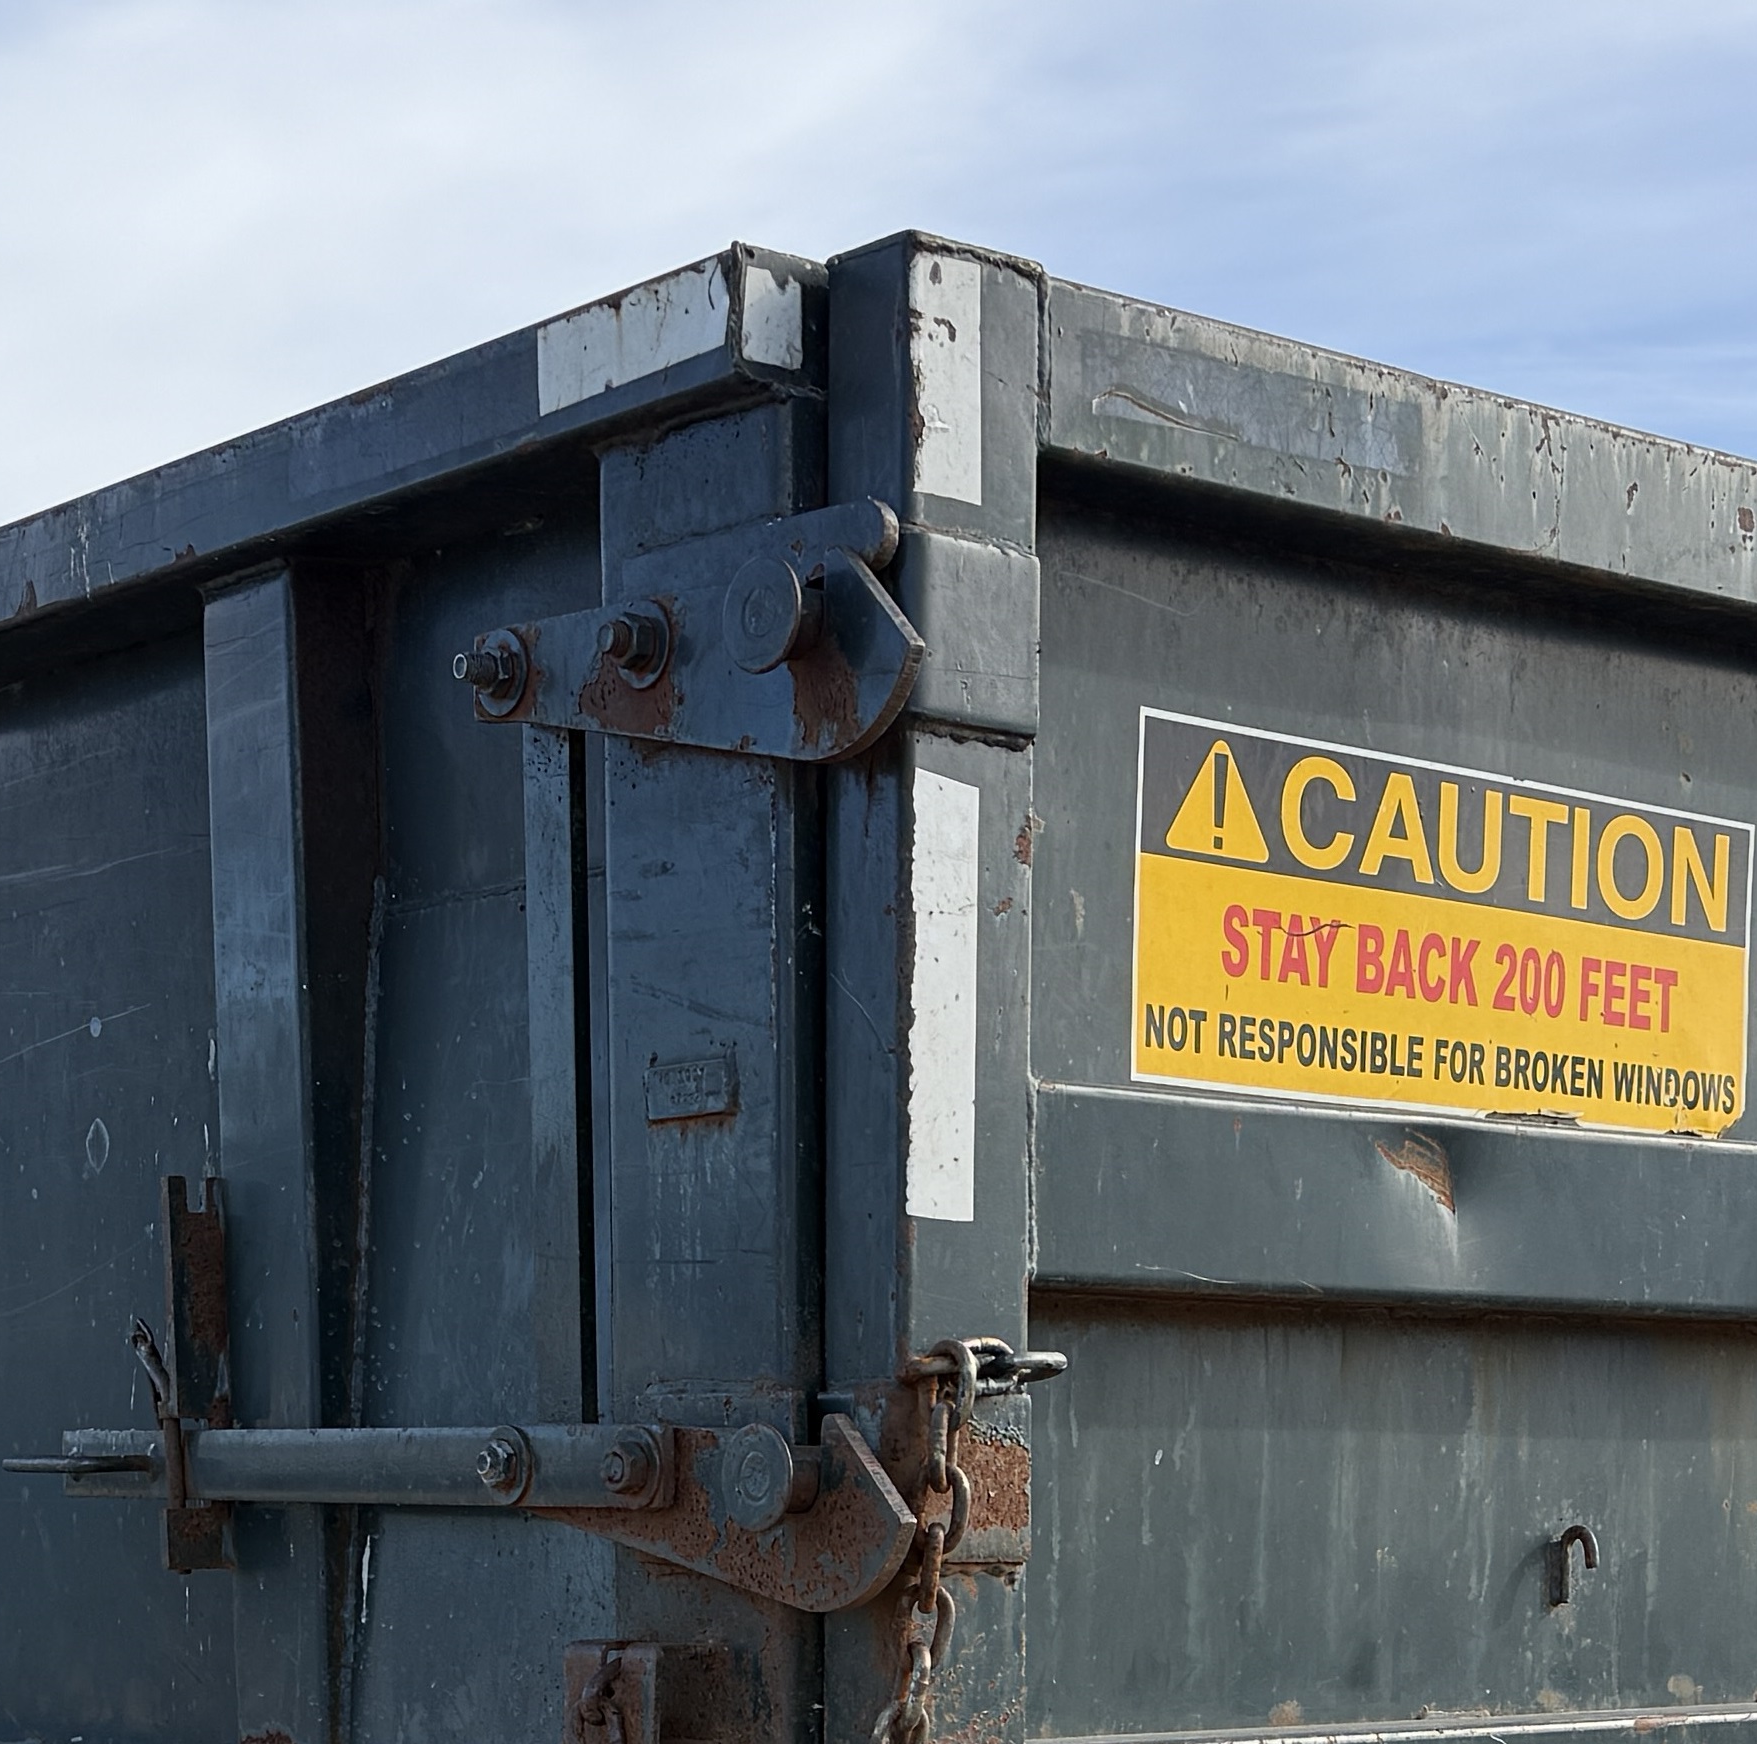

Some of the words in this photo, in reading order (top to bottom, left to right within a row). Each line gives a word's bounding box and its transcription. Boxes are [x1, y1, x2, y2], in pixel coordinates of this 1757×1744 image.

[1281, 755, 1730, 932] CAUTION
[1221, 904, 1341, 988] STAY
[1356, 924, 1479, 1006] BACK
[1493, 943, 1565, 1018] 200
[1579, 956, 1678, 1033] FEET
[1144, 1003, 1206, 1054] NOT
[1218, 1014, 1424, 1078] RESPONSIBLE
[1434, 1039, 1484, 1086] FOR
[1496, 1047, 1603, 1099] BROKEN
[1613, 1061, 1735, 1114] WINDOWS
